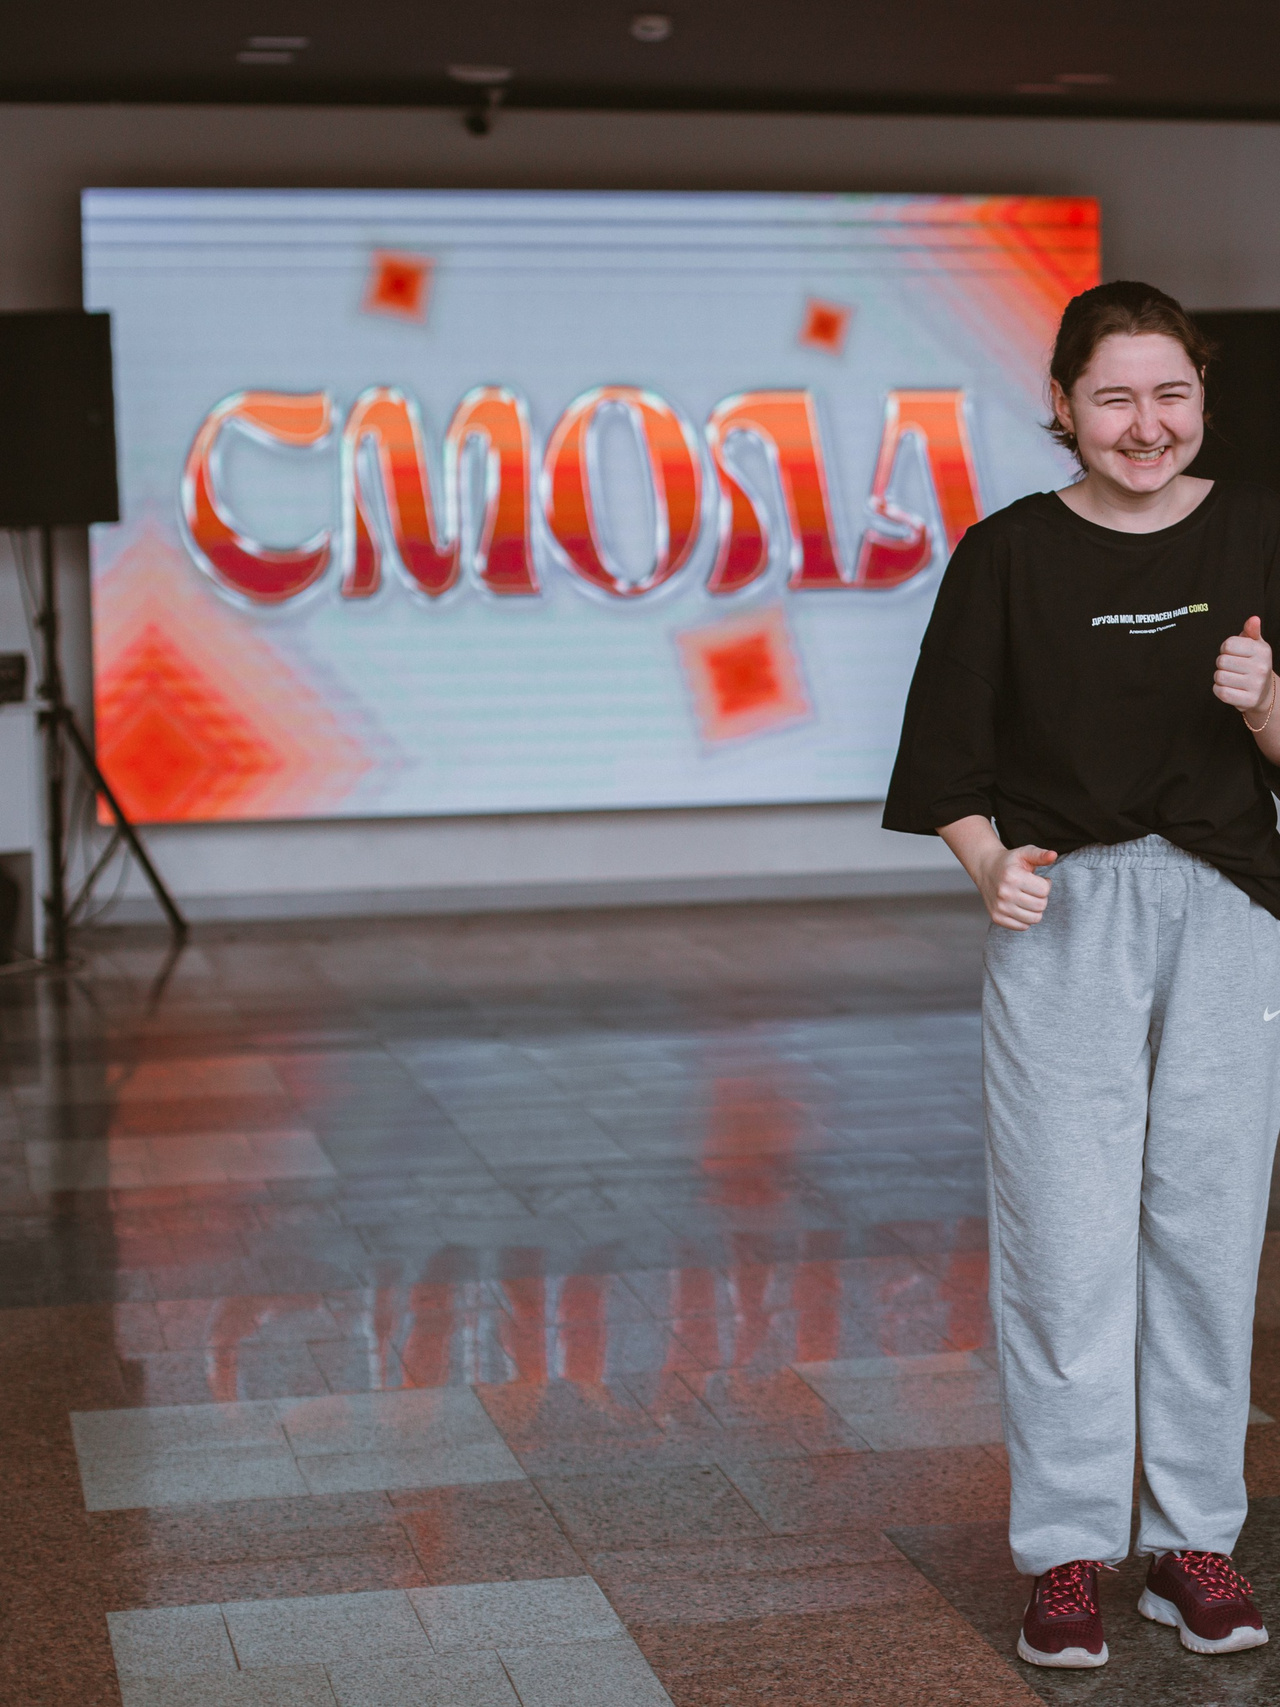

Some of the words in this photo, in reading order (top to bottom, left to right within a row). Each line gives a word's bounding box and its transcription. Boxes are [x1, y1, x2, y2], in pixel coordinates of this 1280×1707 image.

[182, 385, 985, 606] СМОЛА
[1091, 614, 1119, 626] ДРУЗЬЯ
[1119, 614, 1135, 624] МОИ,
[1135, 611, 1172, 624] ПРЕКРАСЕН
[1173, 606, 1188, 617] НАШ
[1188, 603, 1209, 613] СОЮЗ
